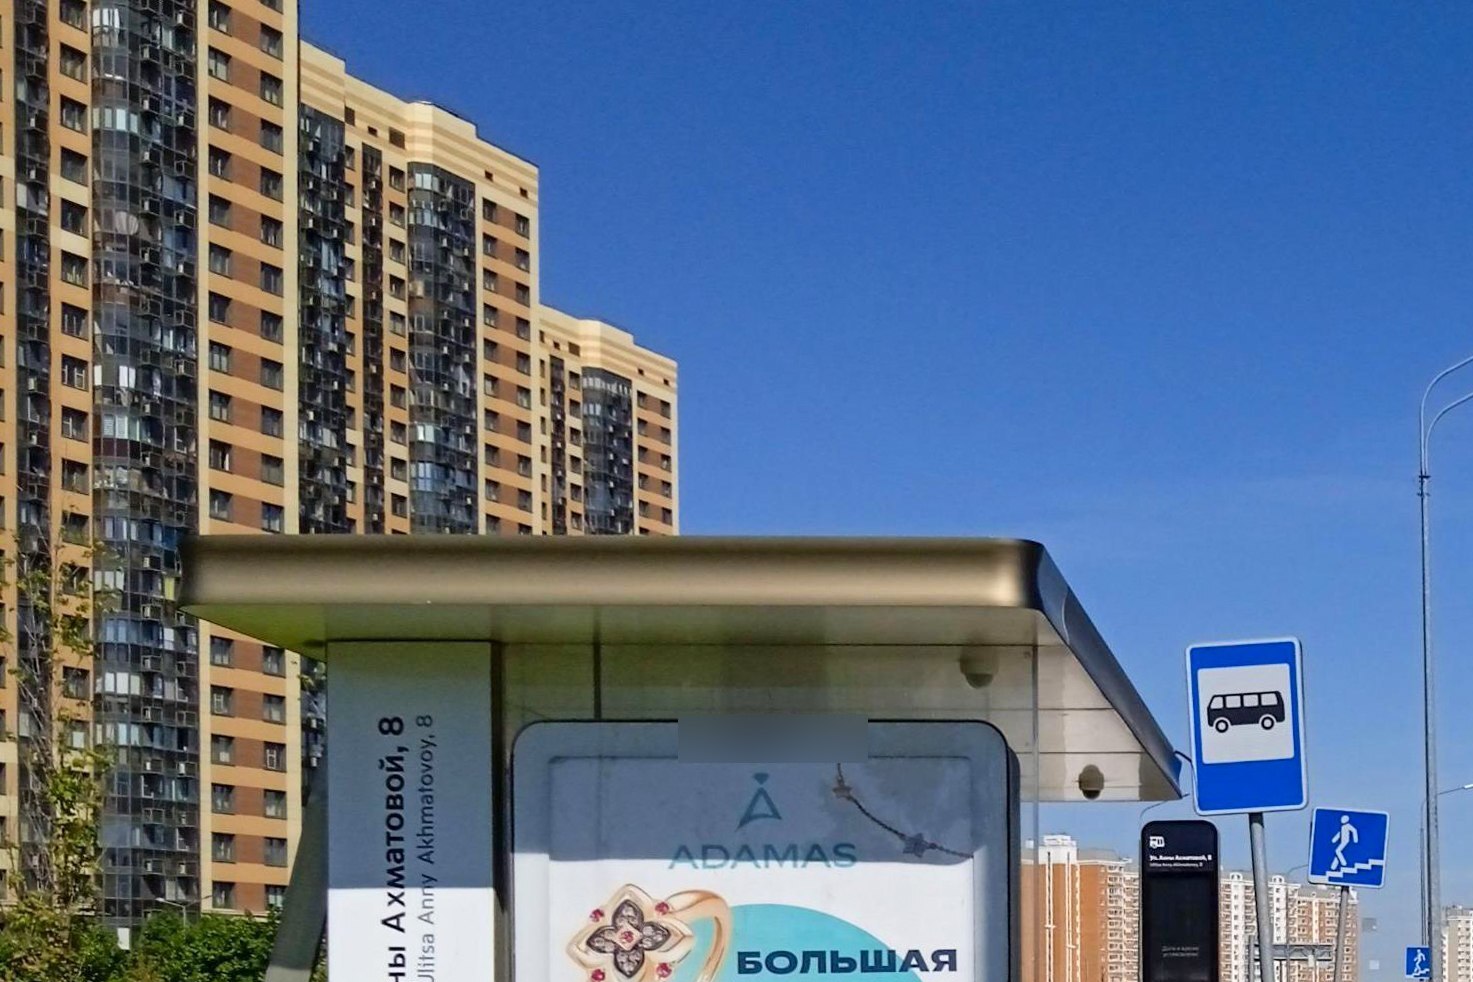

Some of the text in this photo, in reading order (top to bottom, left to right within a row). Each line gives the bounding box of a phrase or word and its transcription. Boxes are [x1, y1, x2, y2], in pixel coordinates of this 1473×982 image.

[378, 716, 404, 736] 8
[416, 714, 433, 728] 8
[416, 734, 438, 865] Akhmatovoy,
[378, 745, 410, 934] Ахматовой,
[668, 842, 858, 870] ADAMAS
[417, 873, 438, 926] Anny
[737, 948, 958, 975] БОЛЬШАЯ
